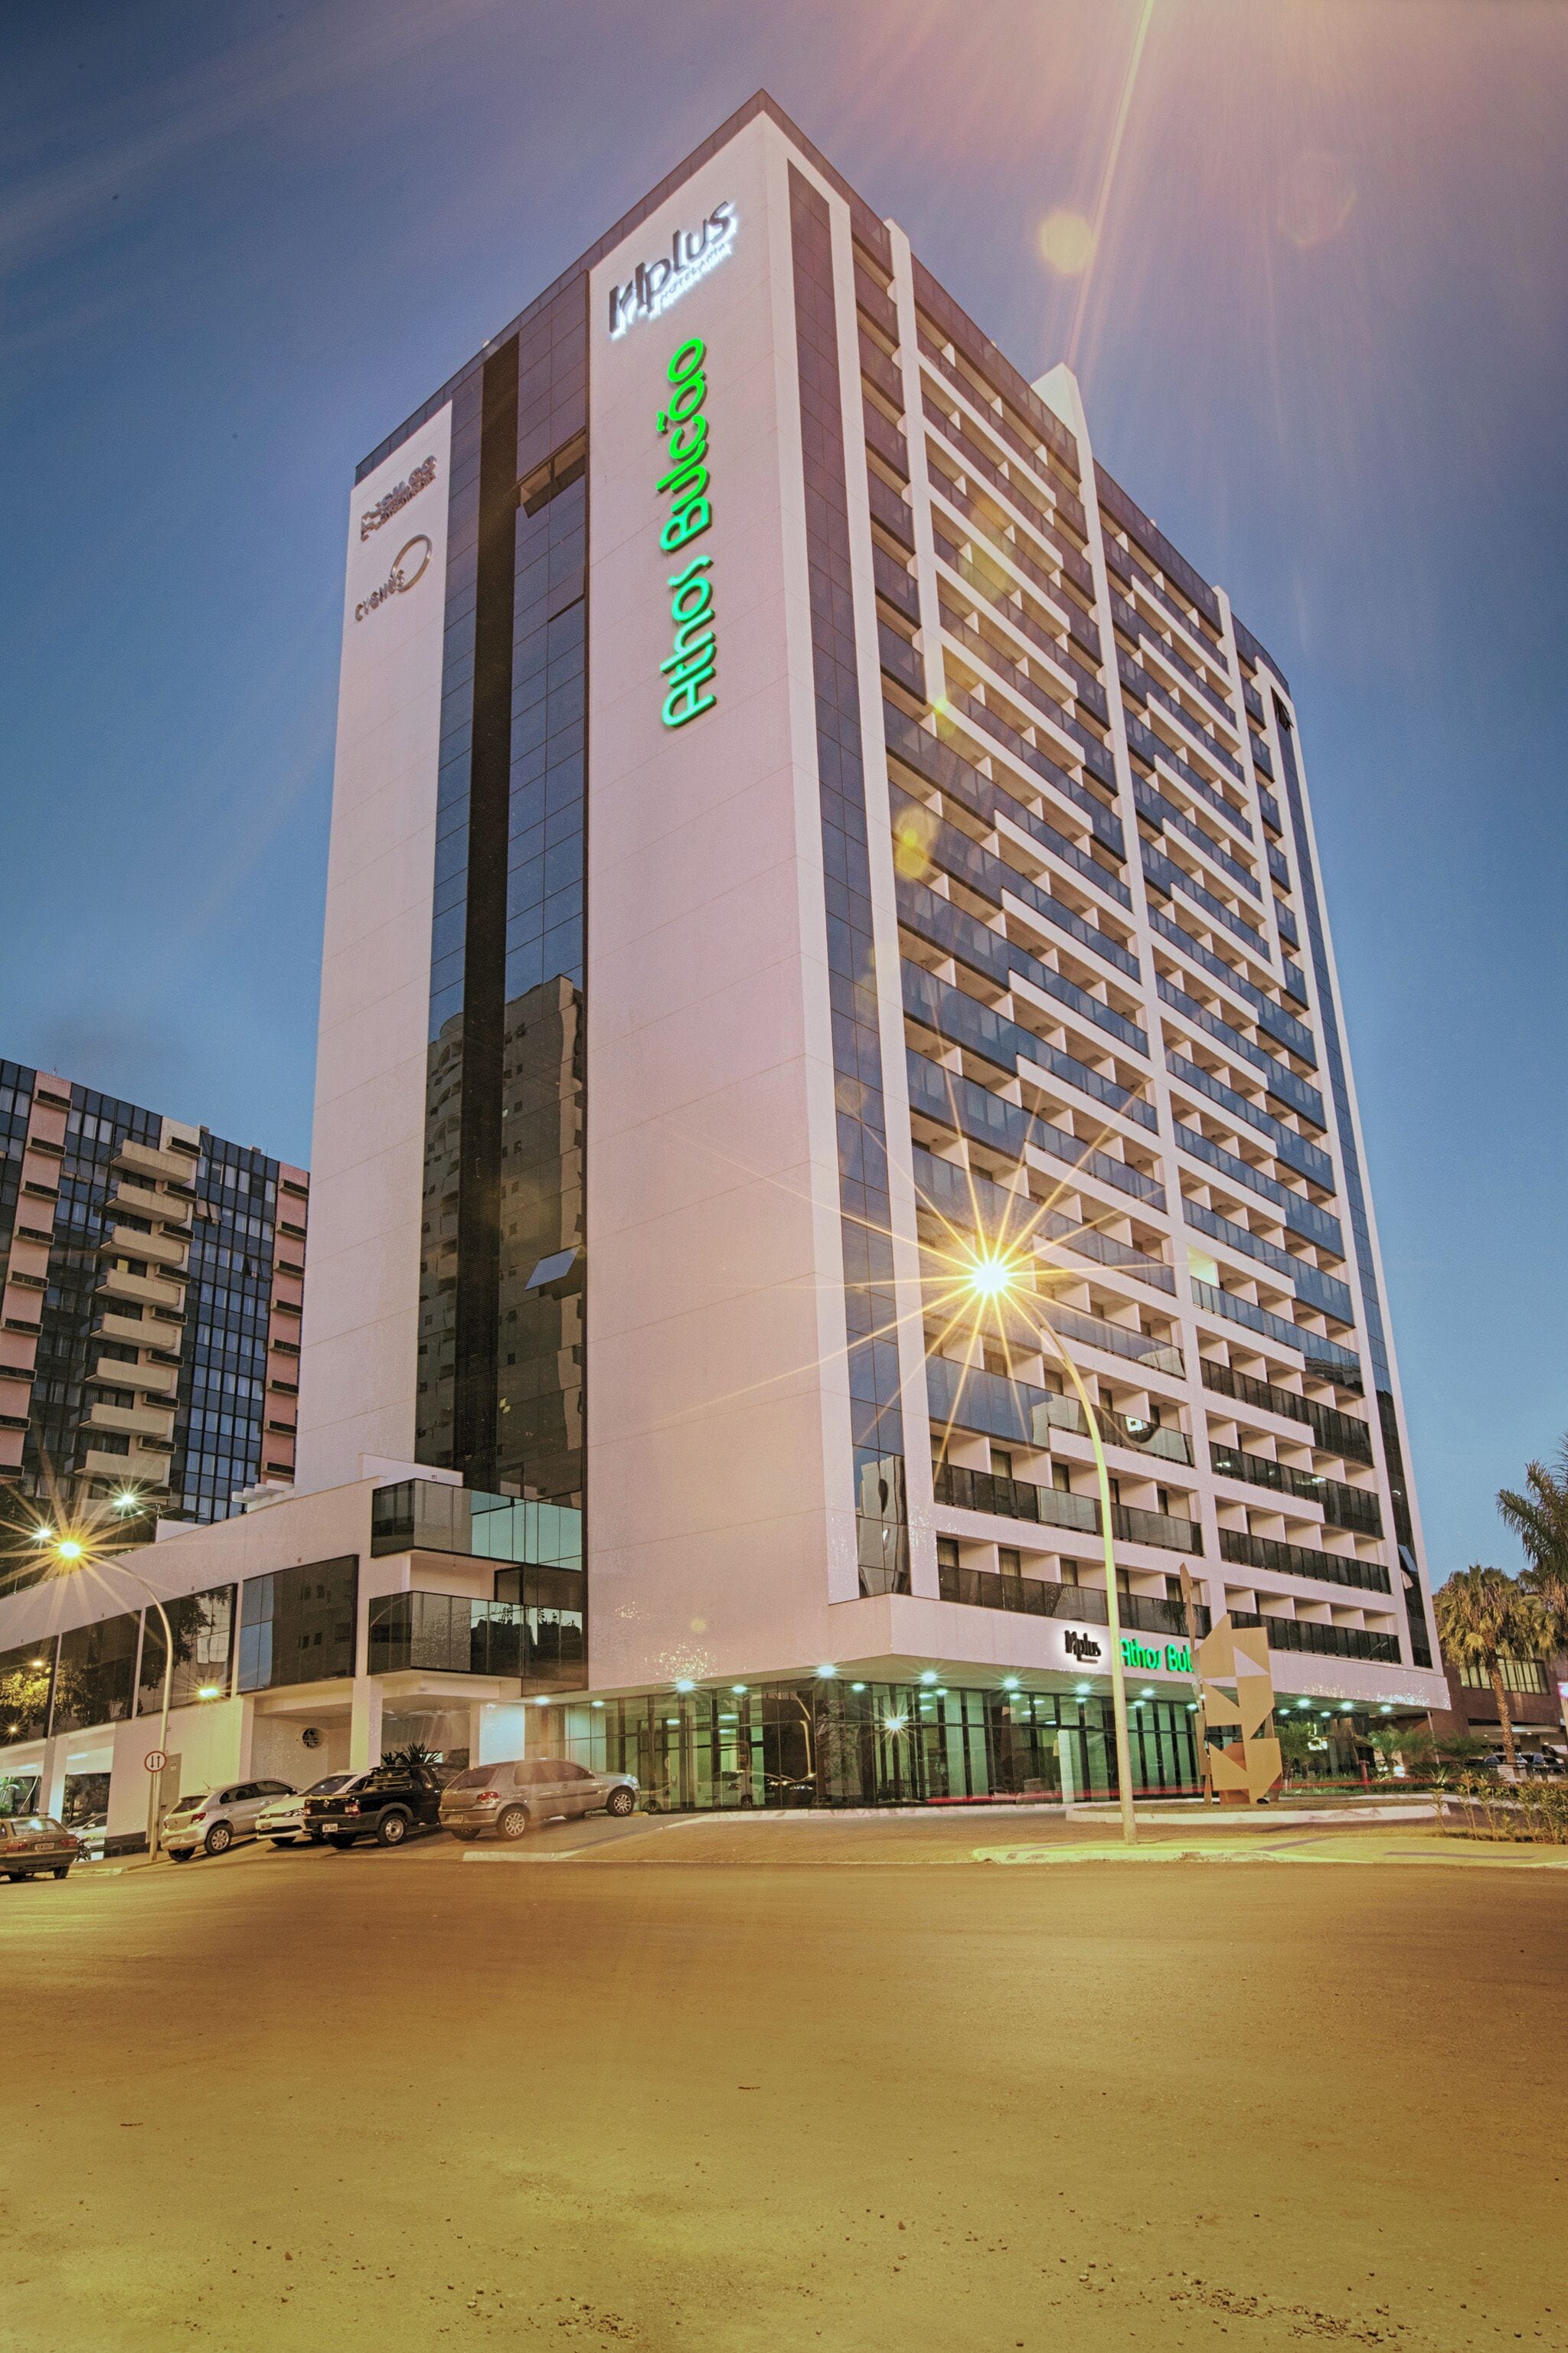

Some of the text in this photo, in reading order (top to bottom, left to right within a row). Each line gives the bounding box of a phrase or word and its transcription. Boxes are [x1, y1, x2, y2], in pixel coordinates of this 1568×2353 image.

[656, 338, 717, 727] Athos Bulcão
[1120, 1637, 1194, 1673] Athos Bul
